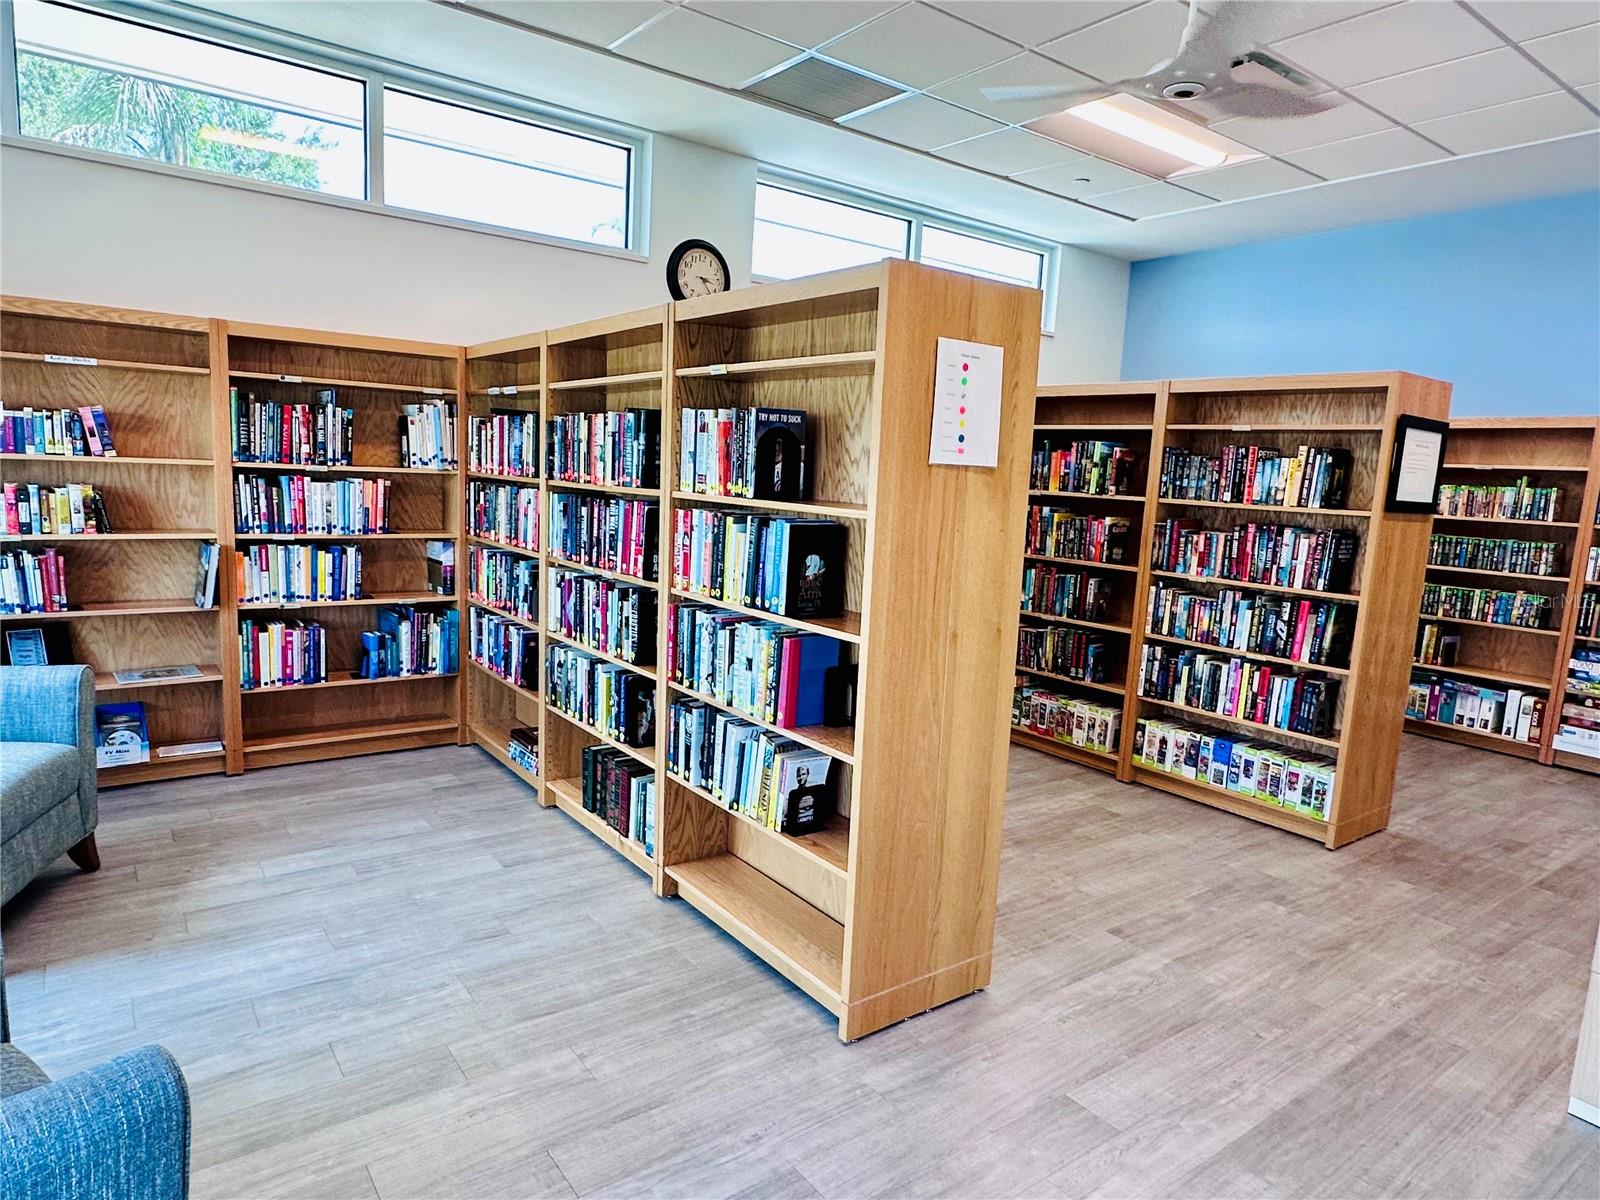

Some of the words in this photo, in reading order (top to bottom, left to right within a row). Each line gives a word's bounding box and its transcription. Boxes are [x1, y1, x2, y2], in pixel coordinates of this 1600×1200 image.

[691, 255, 698, 263] 11
[698, 254, 707, 263] 12
[684, 260, 692, 269] 10
[758, 413, 768, 421] TRY
[769, 413, 780, 422] NOT
[780, 414, 787, 422] TO
[788, 415, 801, 424] SUCK
